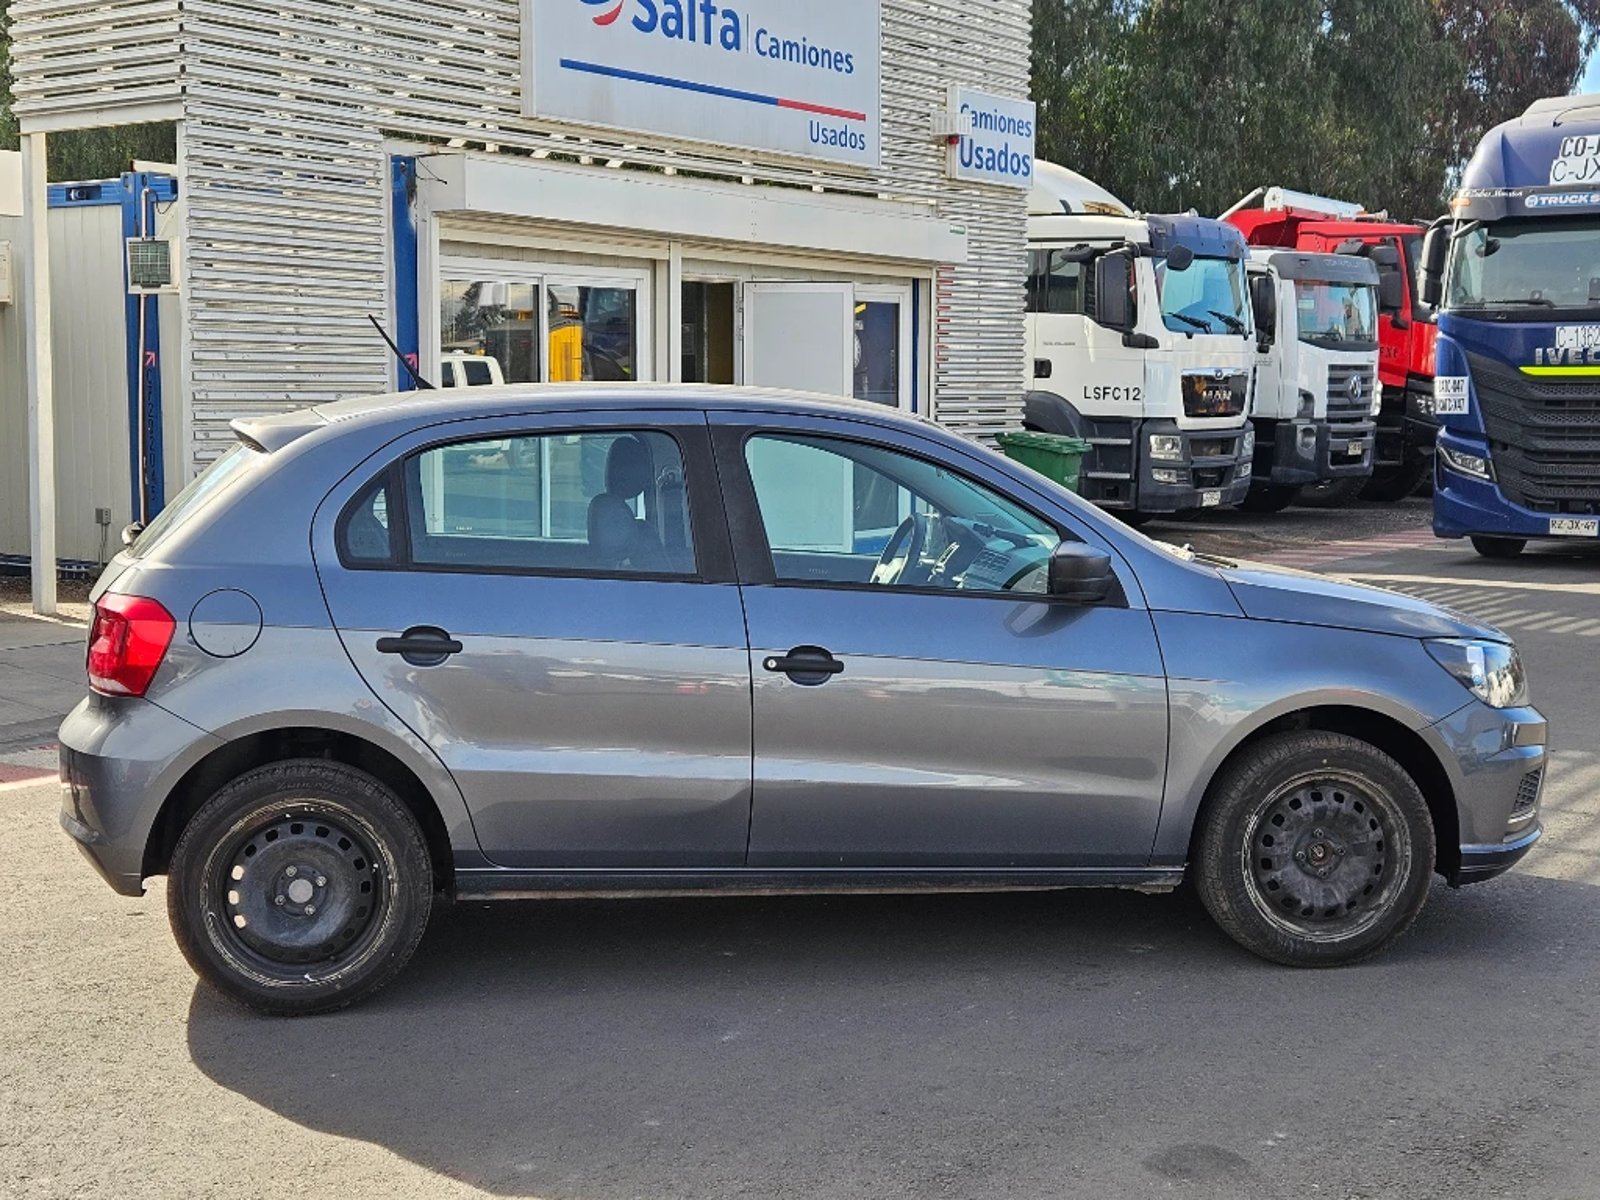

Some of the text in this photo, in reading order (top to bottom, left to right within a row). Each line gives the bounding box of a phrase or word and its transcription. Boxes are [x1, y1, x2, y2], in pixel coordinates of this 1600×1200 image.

[631, 0, 855, 75] Salfa Camiones
[809, 119, 866, 151] Usados
[960, 134, 1031, 177] Usados
[1539, 194, 1588, 206] TRUCK
[1083, 385, 1141, 401] LSFC12
